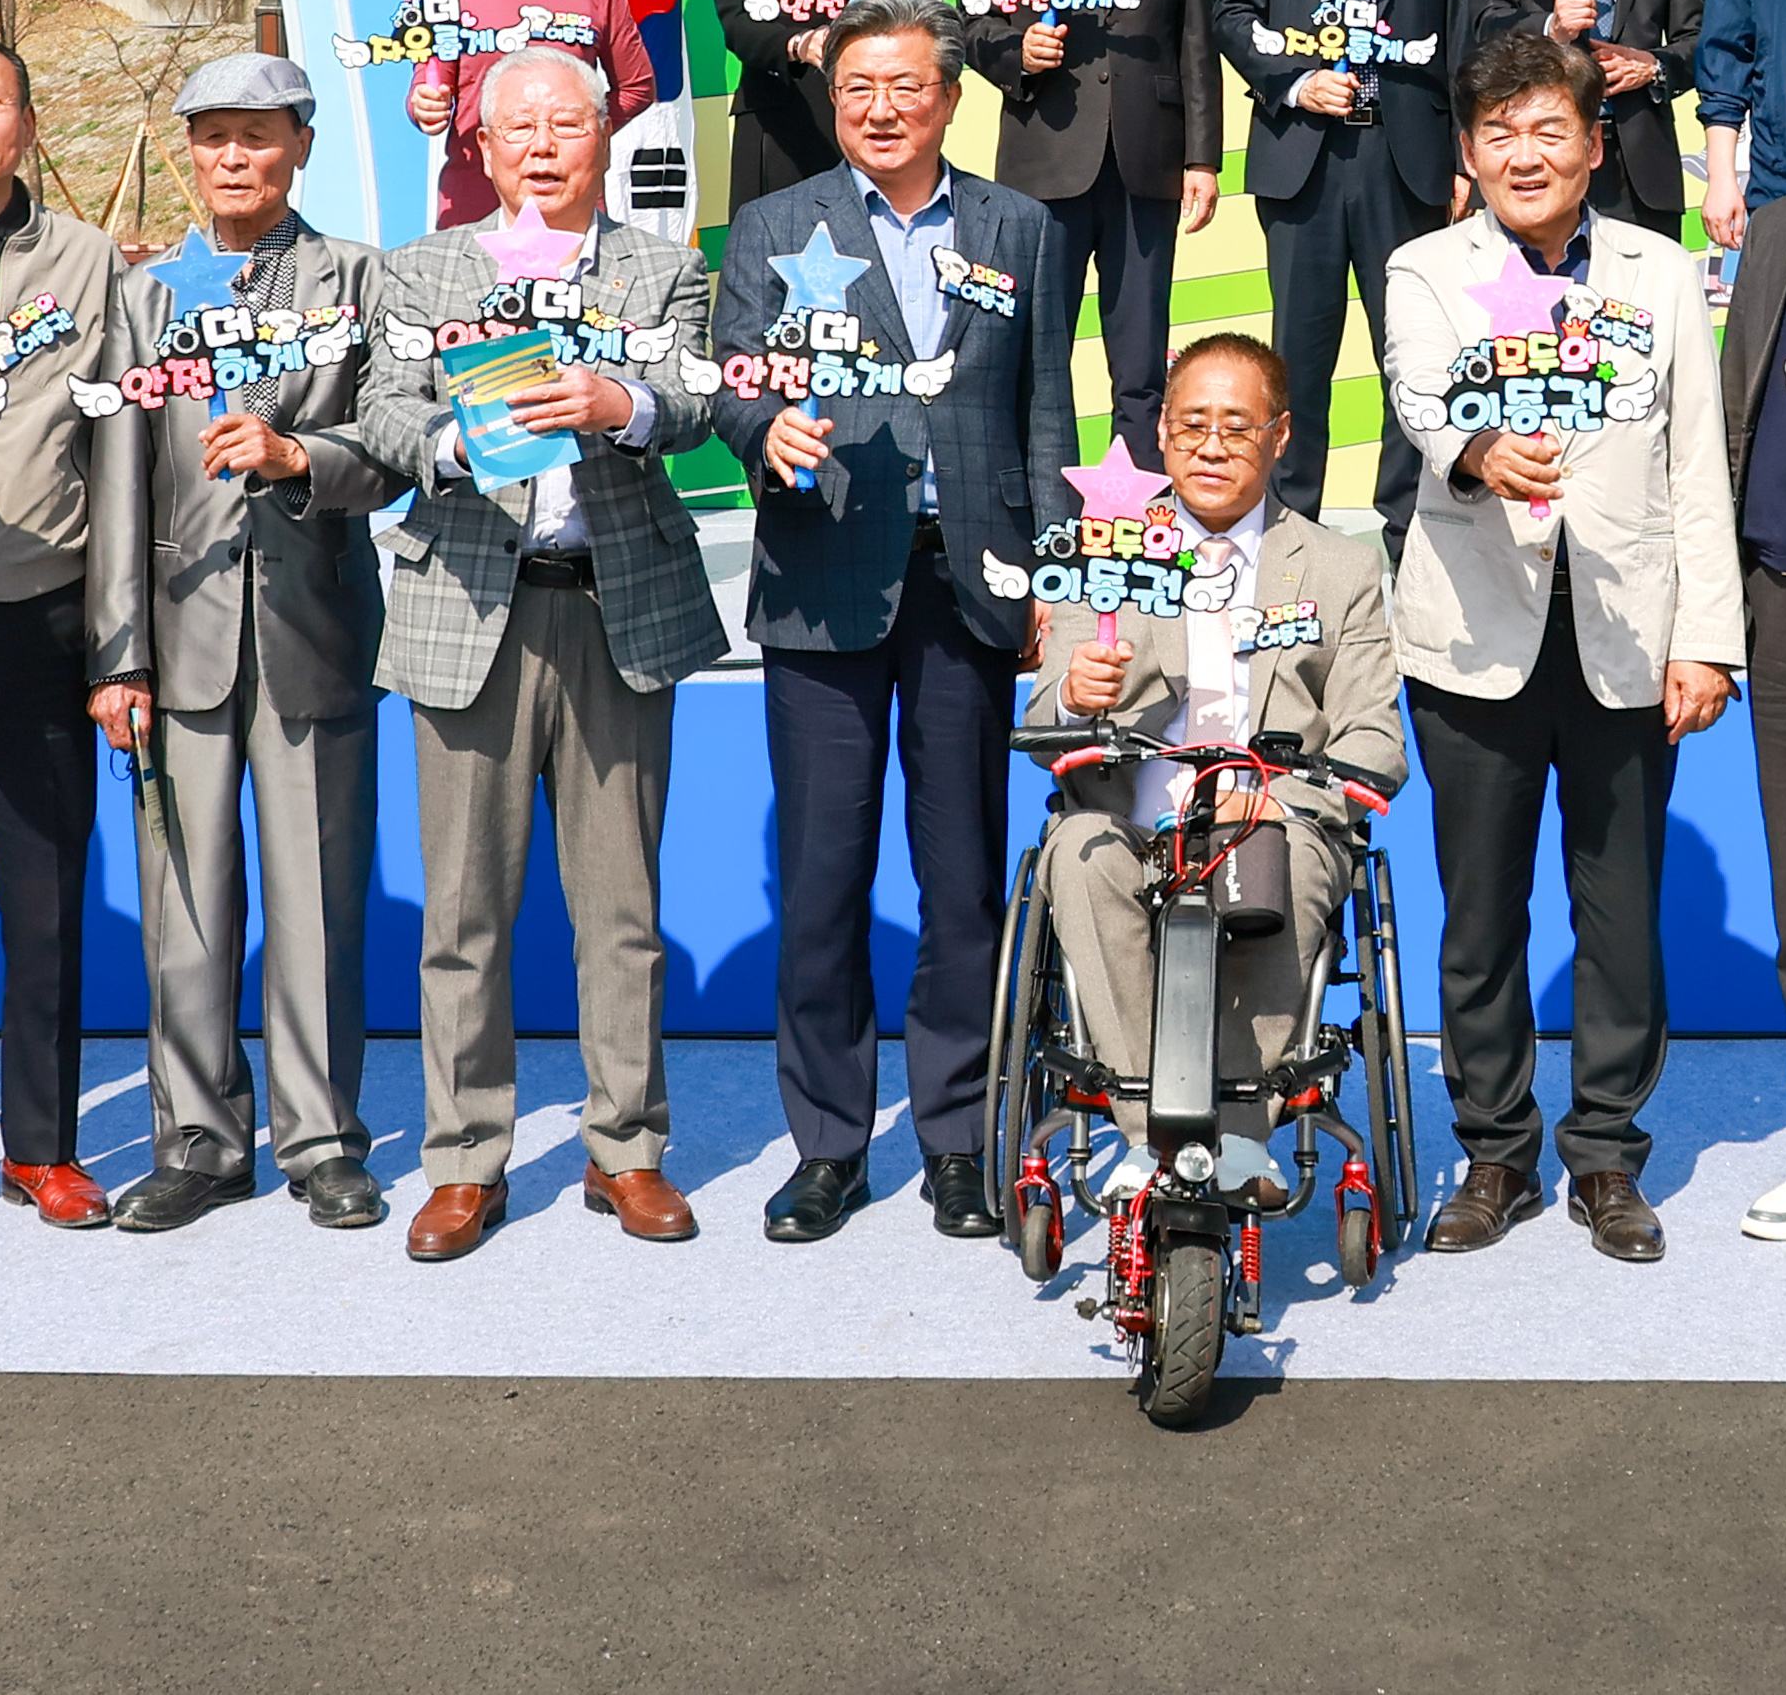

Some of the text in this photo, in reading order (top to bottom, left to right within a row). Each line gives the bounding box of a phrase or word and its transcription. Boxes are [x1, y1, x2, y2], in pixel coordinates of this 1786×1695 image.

[1343, 0, 1377, 28] 더
[368, 22, 495, 65] 자유롭게
[1284, 24, 1403, 64] 자유롭게
[971, 262, 1016, 292] 모두의
[9, 292, 56, 330] 모두의
[531, 278, 582, 319] 더
[960, 282, 1017, 317] 이동권
[1603, 297, 1654, 327] 모두의
[15, 307, 76, 354] 이동권
[200, 306, 255, 348] 더
[809, 310, 860, 352] 더
[1589, 317, 1654, 354] 이동권
[1494, 331, 1600, 376] 모두의
[120, 340, 306, 409] 안전하게
[723, 351, 903, 400] 안전하게
[1449, 375, 1604, 434] 이동권
[1080, 517, 1183, 560] 모두의
[1031, 557, 1183, 617] 이동권
[1265, 600, 1318, 625] 모두의
[1256, 619, 1320, 648] 이동권
